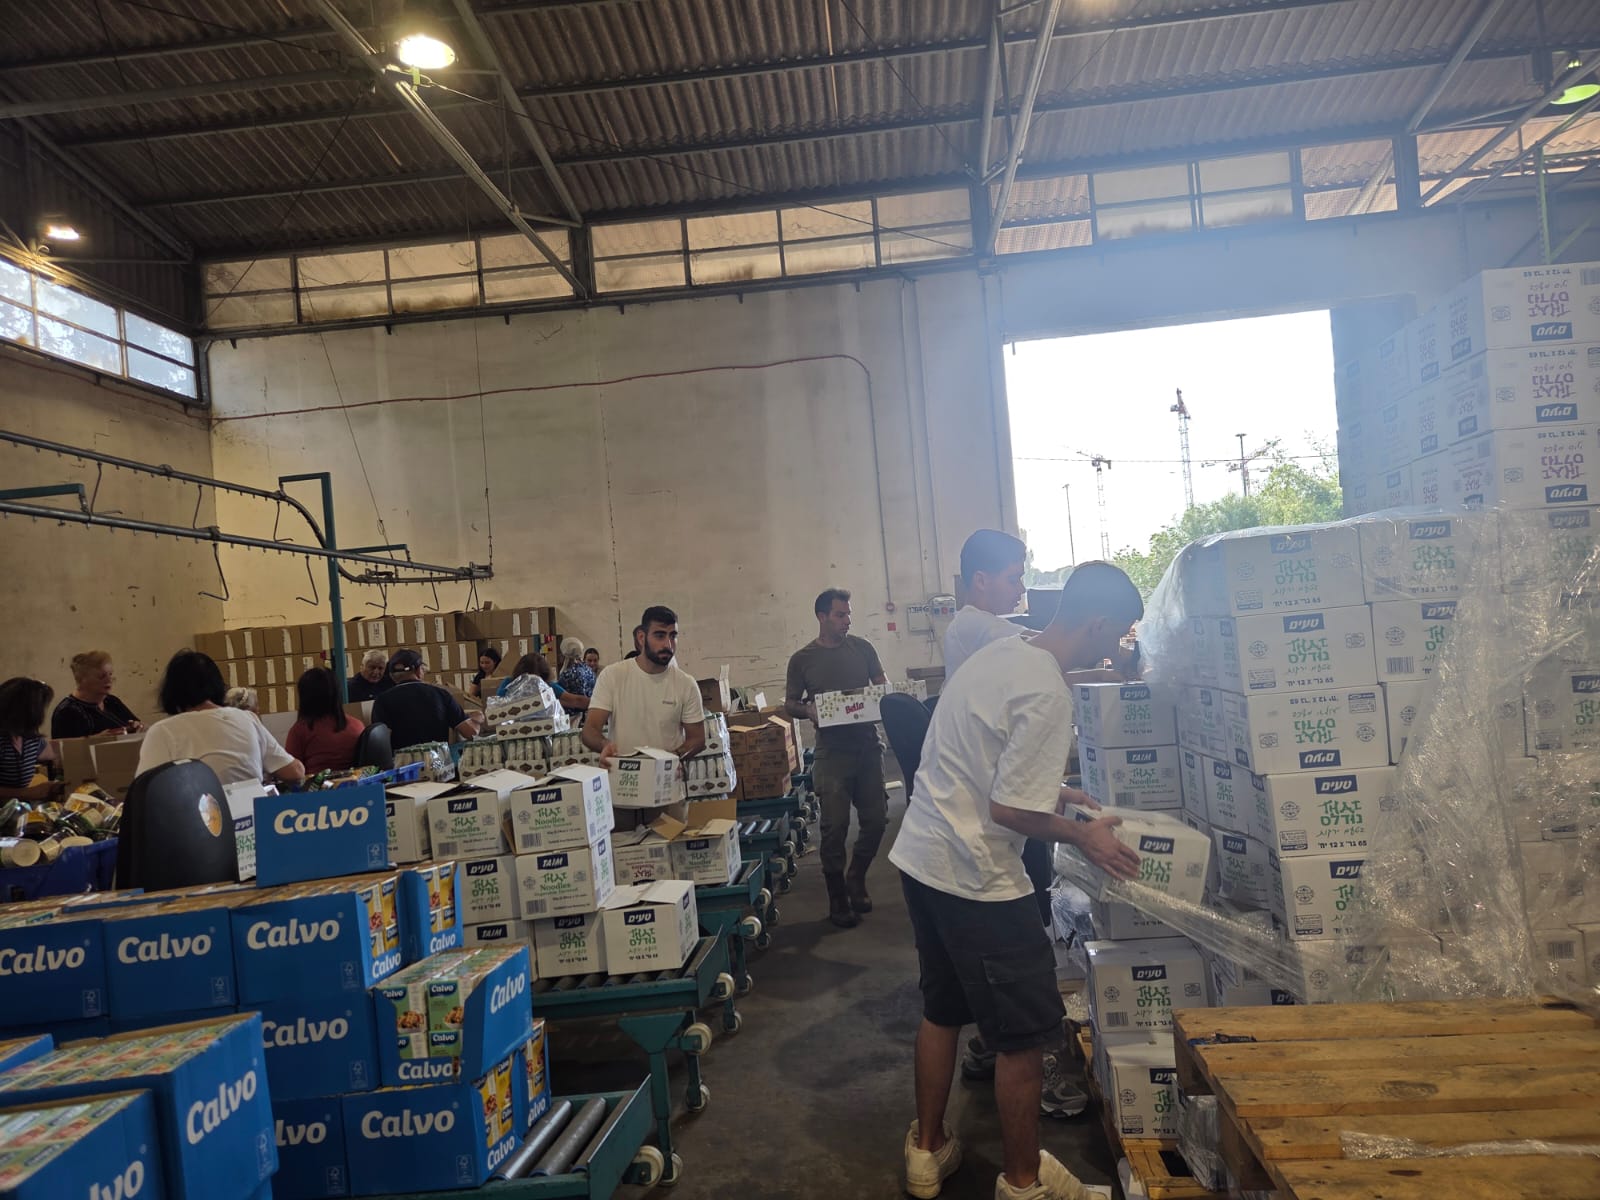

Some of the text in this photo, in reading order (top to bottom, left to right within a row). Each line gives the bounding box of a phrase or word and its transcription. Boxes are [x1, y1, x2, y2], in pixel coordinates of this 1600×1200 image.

[1289, 618, 1320, 630] טעים
[1304, 752, 1335, 763] טעים
[1320, 780, 1352, 792] טעים
[536, 792, 557, 802] TAIM
[452, 801, 473, 811] TAIM
[274, 806, 369, 835] Calvo
[1143, 840, 1171, 852] טעים
[470, 864, 494, 874] טעים
[542, 857, 563, 868] TAIM
[1336, 866, 1360, 876] עים
[628, 912, 652, 923] טעים
[247, 918, 340, 950] Calvo
[482, 928, 502, 938] TAIM
[118, 932, 212, 964] Calvo
[430, 933, 456, 953] Calvo
[0, 946, 85, 976] Calvo
[372, 952, 402, 978] Calvo
[1137, 969, 1162, 978] טעים
[431, 984, 454, 992] Calvo
[490, 972, 526, 1014] Calvo
[262, 1017, 348, 1048] Calvo
[432, 1034, 455, 1042] Calvo
[398, 1061, 461, 1080] Calvo
[186, 1070, 257, 1145] Calvo
[361, 1109, 456, 1140] Calvo
[275, 1120, 327, 1146] lvo
[487, 1136, 515, 1170] Calvo
[90, 1160, 144, 1200] lvo
